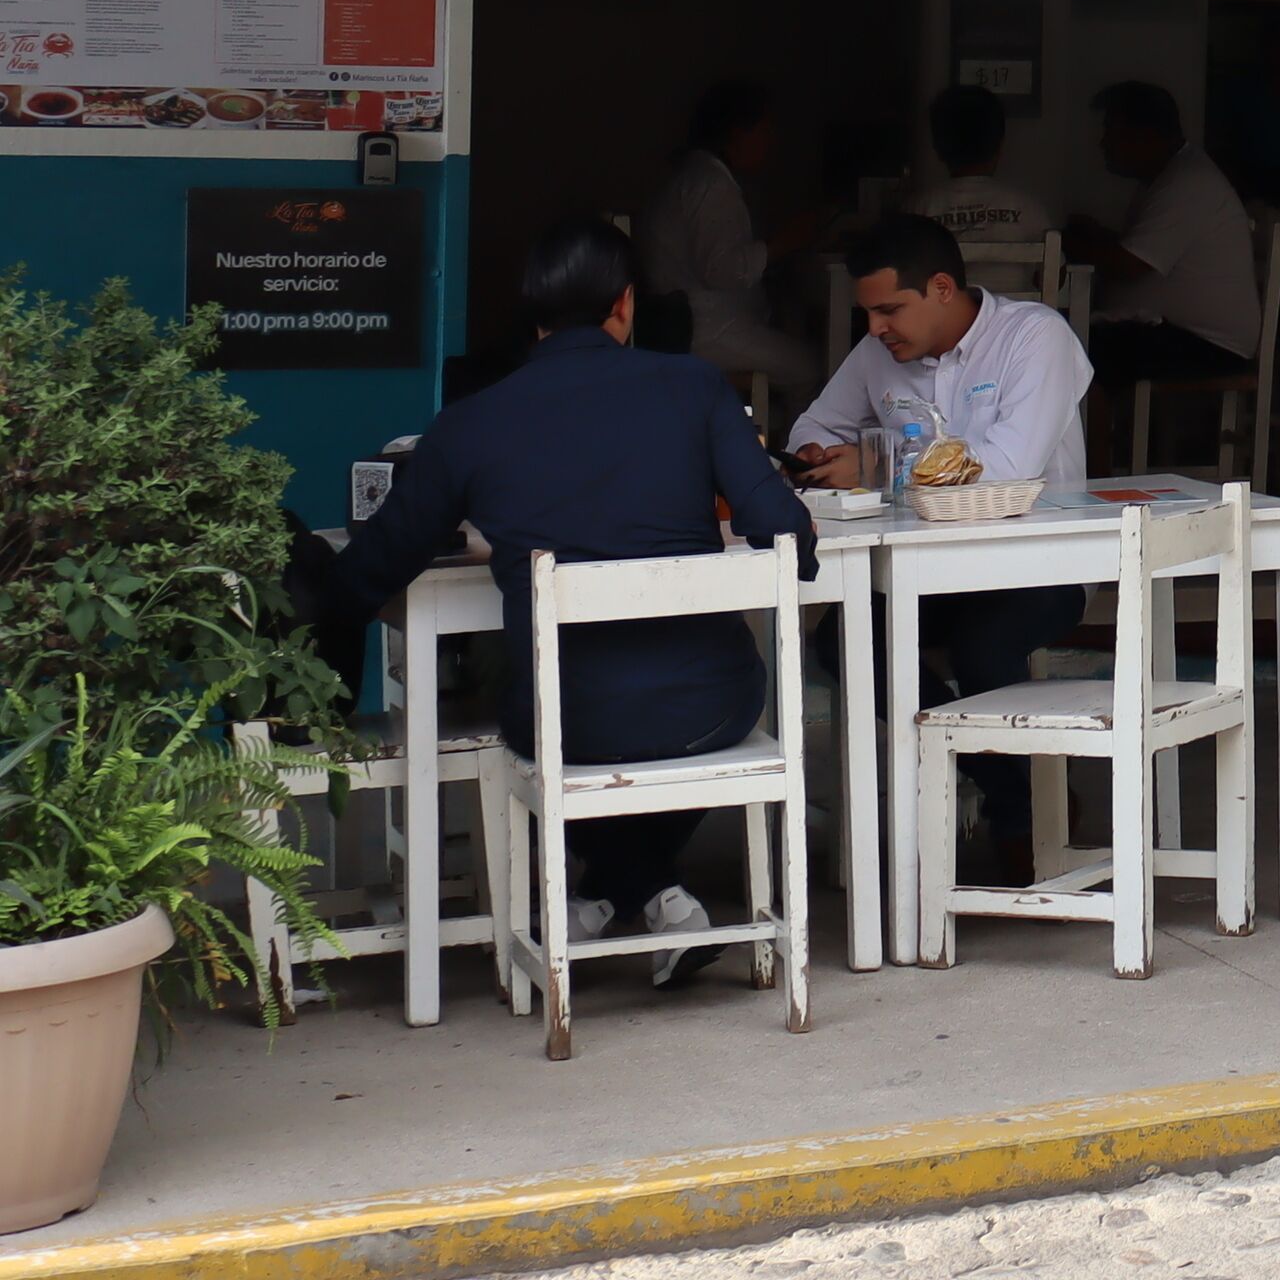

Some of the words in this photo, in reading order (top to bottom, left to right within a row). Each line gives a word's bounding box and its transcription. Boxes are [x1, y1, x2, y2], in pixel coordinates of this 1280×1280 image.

[216, 252, 291, 268] Nuestro
[293, 251, 360, 268] horario
[362, 251, 387, 268] de
[263, 275, 339, 292] servicio:
[263, 316, 295, 333] pm
[297, 316, 310, 329] a
[312, 312, 353, 329] 9:00
[356, 314, 388, 332] pm
